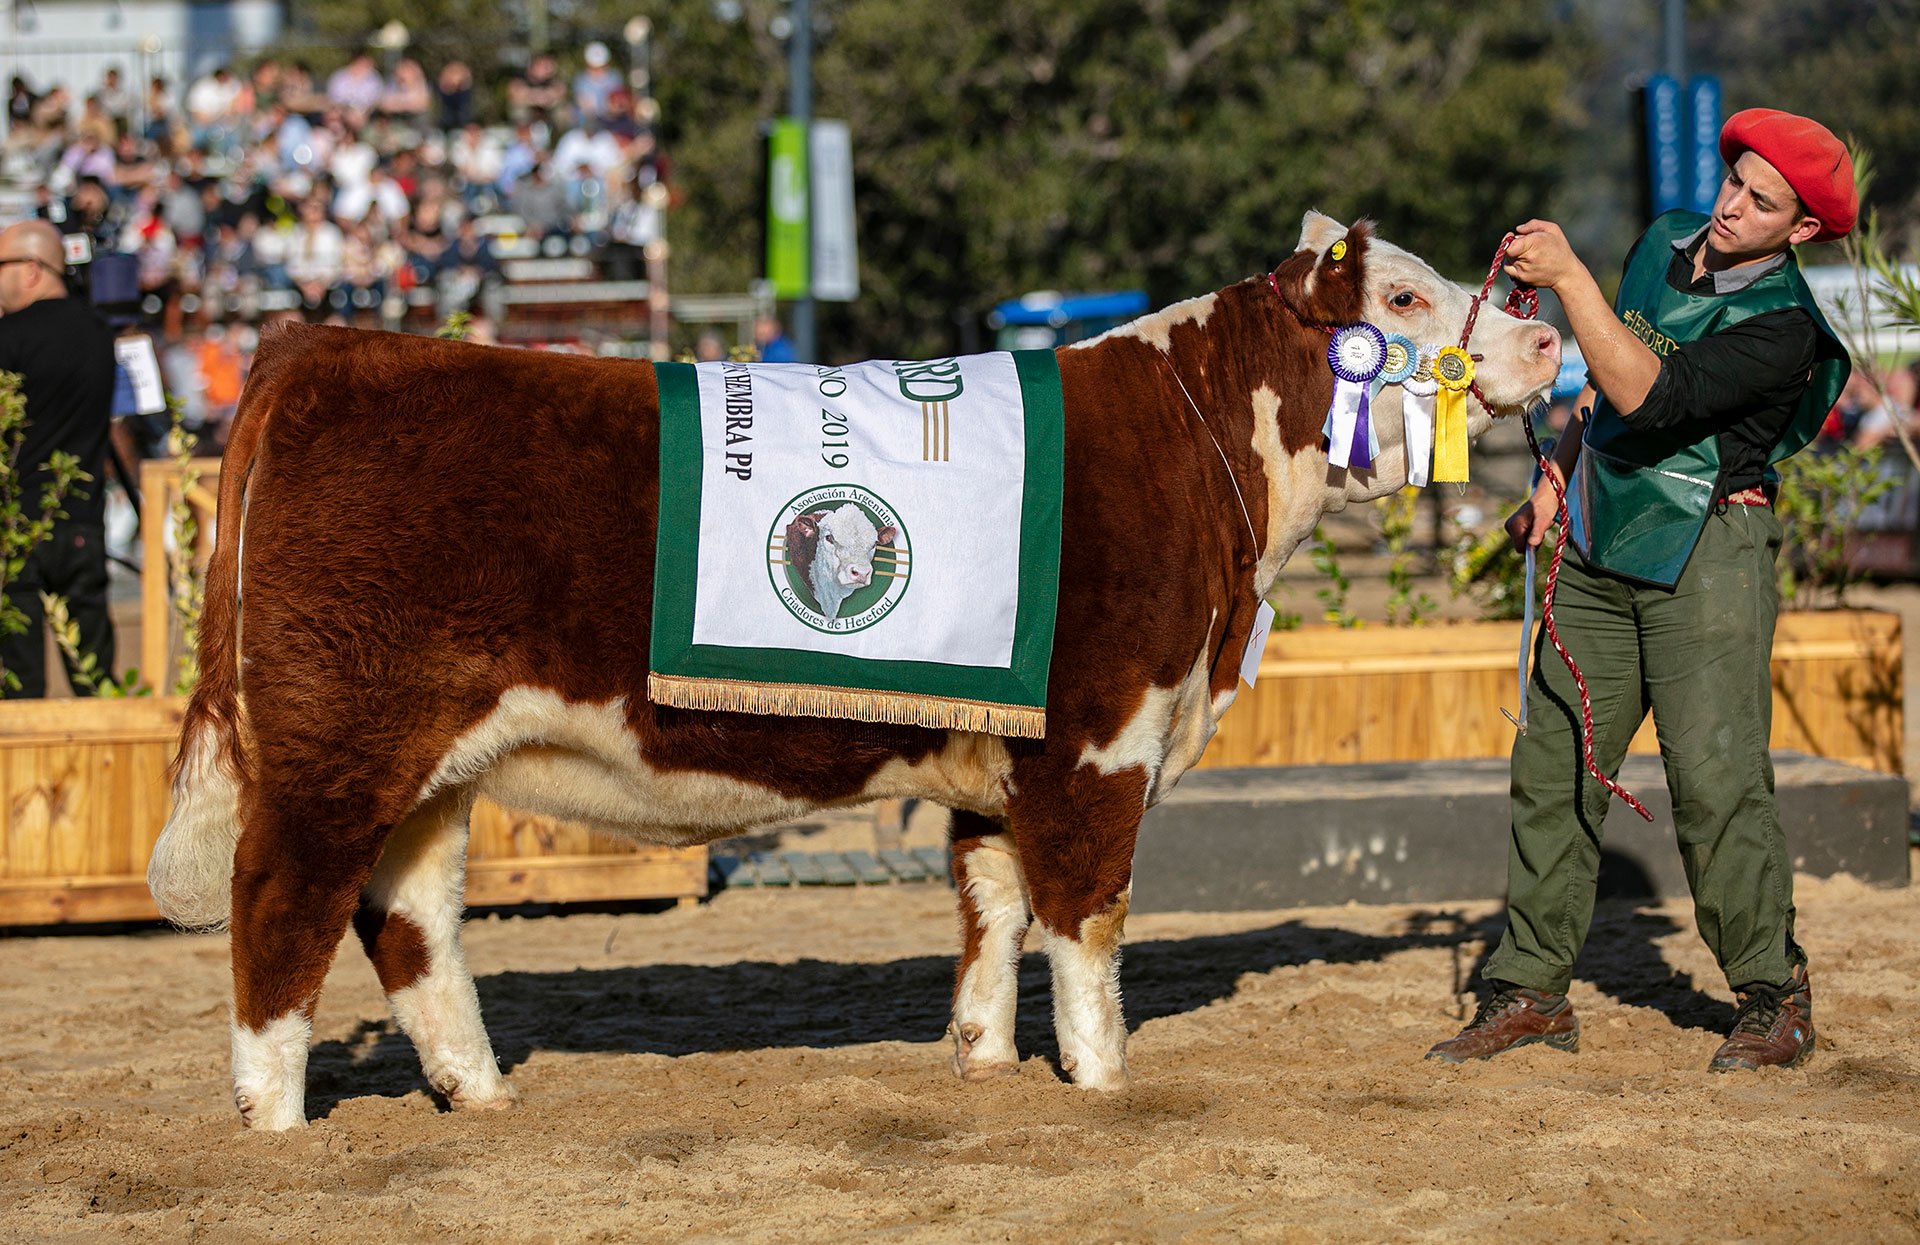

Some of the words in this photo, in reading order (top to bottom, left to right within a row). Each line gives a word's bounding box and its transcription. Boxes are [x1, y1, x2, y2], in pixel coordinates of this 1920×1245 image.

[1624, 310, 1680, 356] HERORD
[724, 374, 753, 446] HEMBRA
[821, 407, 849, 469] 2019
[725, 451, 753, 481] PP
[790, 488, 846, 515] Asociación
[849, 489, 895, 527] Argentina
[781, 587, 824, 627] Criadores
[827, 619, 841, 630] de
[845, 597, 893, 629] Hereford
